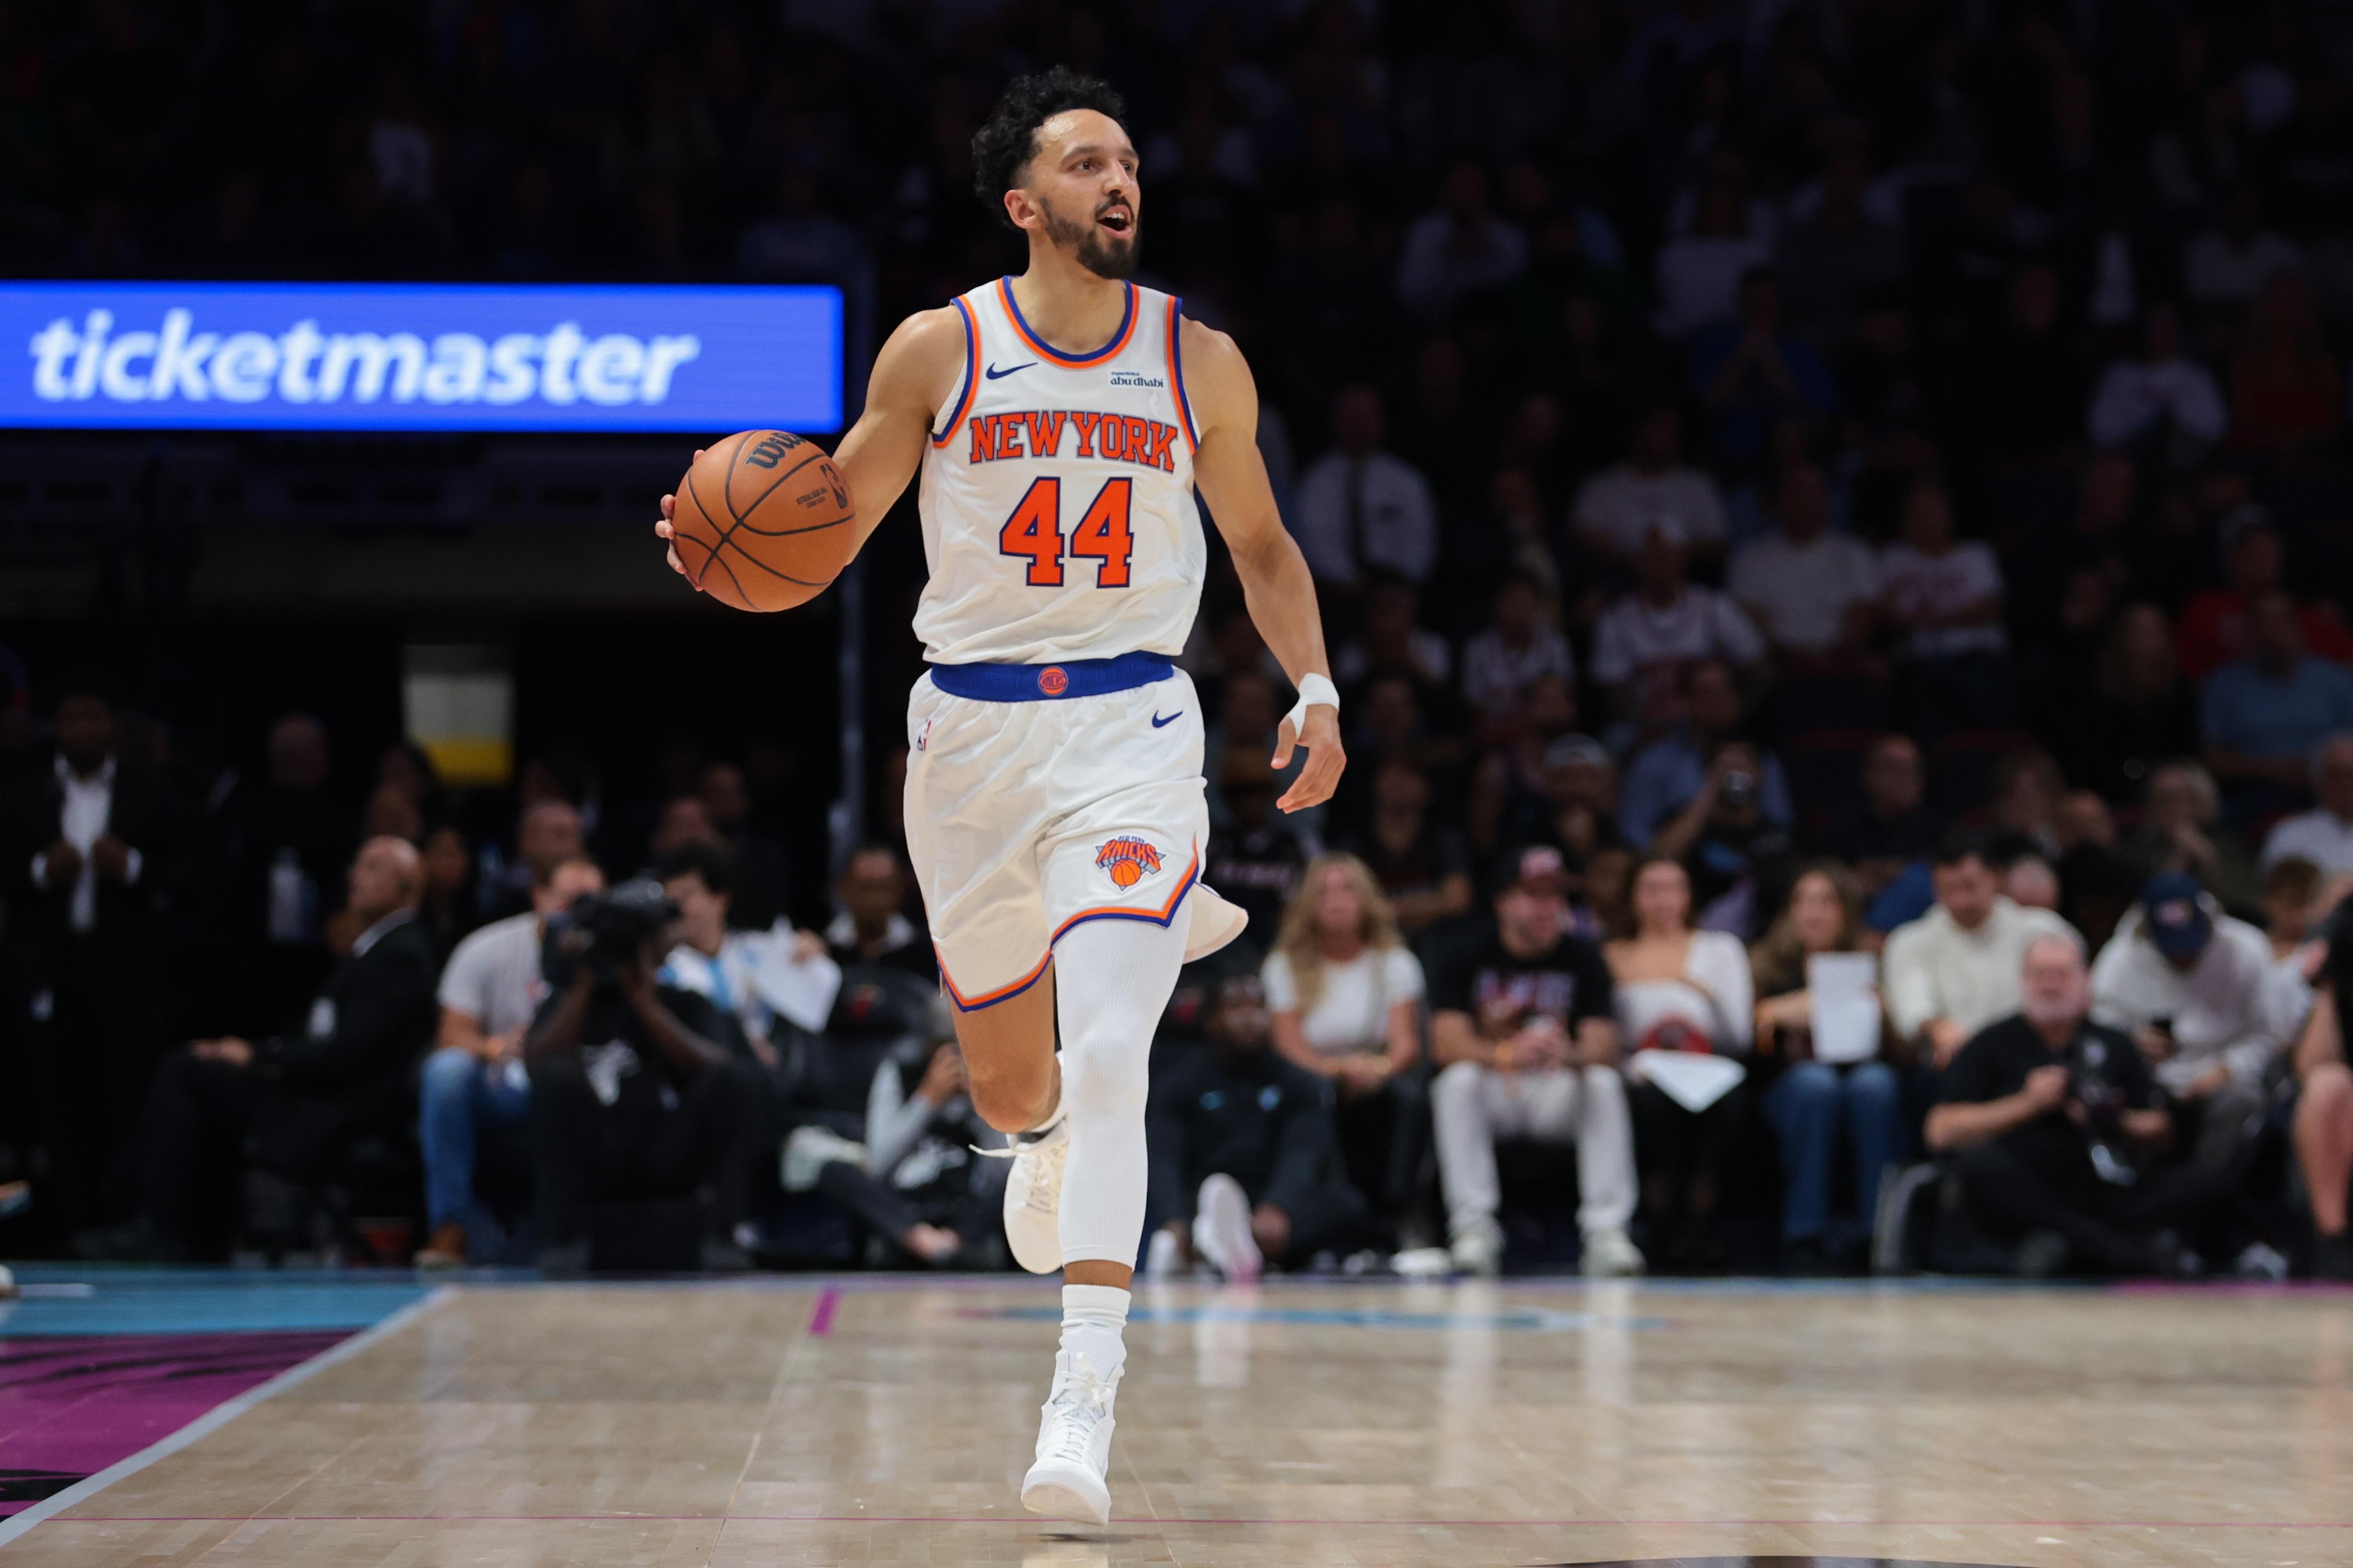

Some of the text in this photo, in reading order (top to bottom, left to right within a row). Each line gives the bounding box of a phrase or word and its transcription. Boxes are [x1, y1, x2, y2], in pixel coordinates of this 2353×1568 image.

[31, 308, 698, 403] ticketmaster
[1111, 377, 1164, 387] abu dhabi
[970, 410, 1178, 474] NEW YORK
[999, 476, 1135, 589] 44
[1095, 839, 1161, 874] KNICKS
